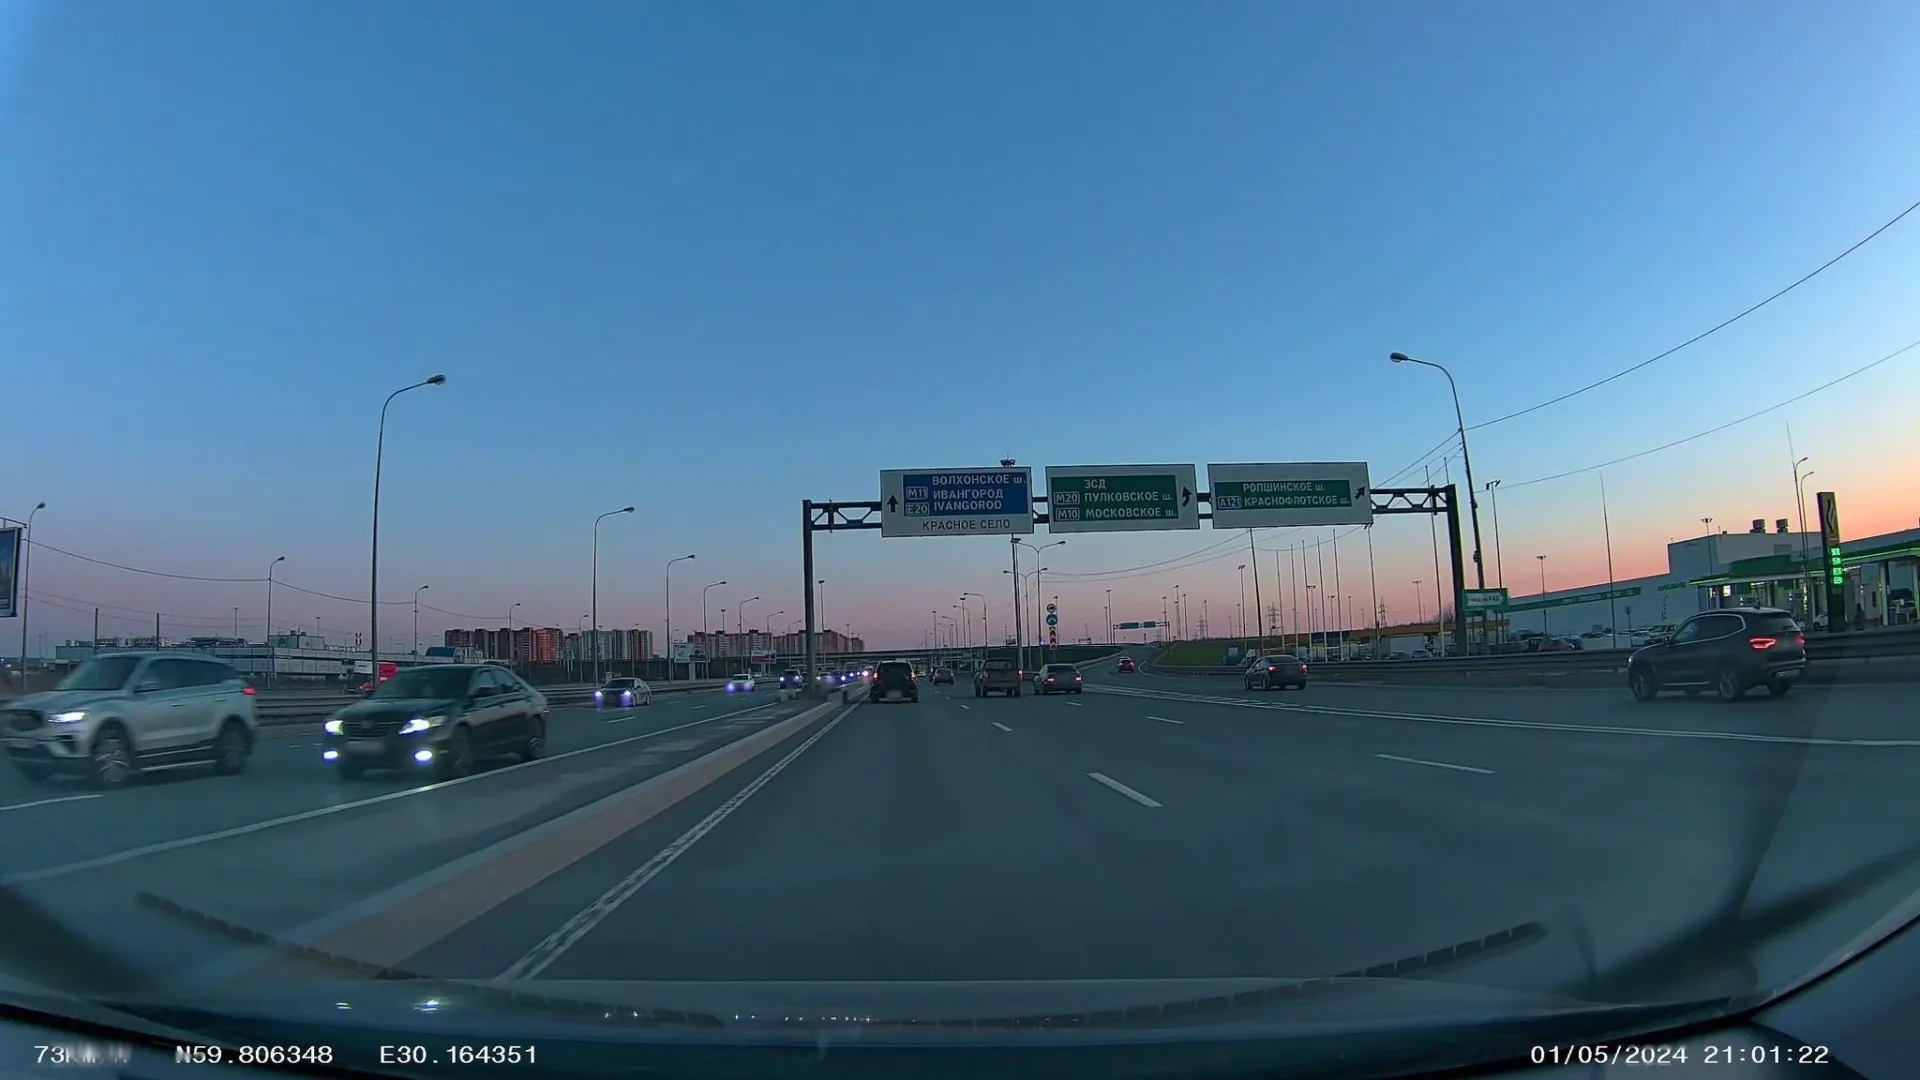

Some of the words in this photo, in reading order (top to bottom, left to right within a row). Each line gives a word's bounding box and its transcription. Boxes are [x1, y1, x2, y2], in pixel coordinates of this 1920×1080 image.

[932, 474, 1010, 486] ВОЛХОНСКОЕ
[1013, 476, 1026, 484] ш.
[1084, 479, 1107, 490] ЗСД
[1242, 482, 1313, 493] РОПШИНСКОЕ
[1315, 483, 1325, 491] ш.
[933, 488, 1004, 500] ИВАНГОРОД
[1084, 491, 1159, 503] ПУЛКОВСКОЕ
[1162, 493, 1174, 501] ш.
[934, 500, 1002, 511] IVANGOROD
[1244, 495, 1337, 507] КРАСНОФЛОТСКОЕ
[907, 504, 928, 514] E20
[1085, 507, 1161, 519] МОСКОВСКОЕ
[1165, 509, 1177, 517] ш.
[922, 519, 976, 531] КРАСНОЕ
[979, 519, 1010, 529] СЕЛО
